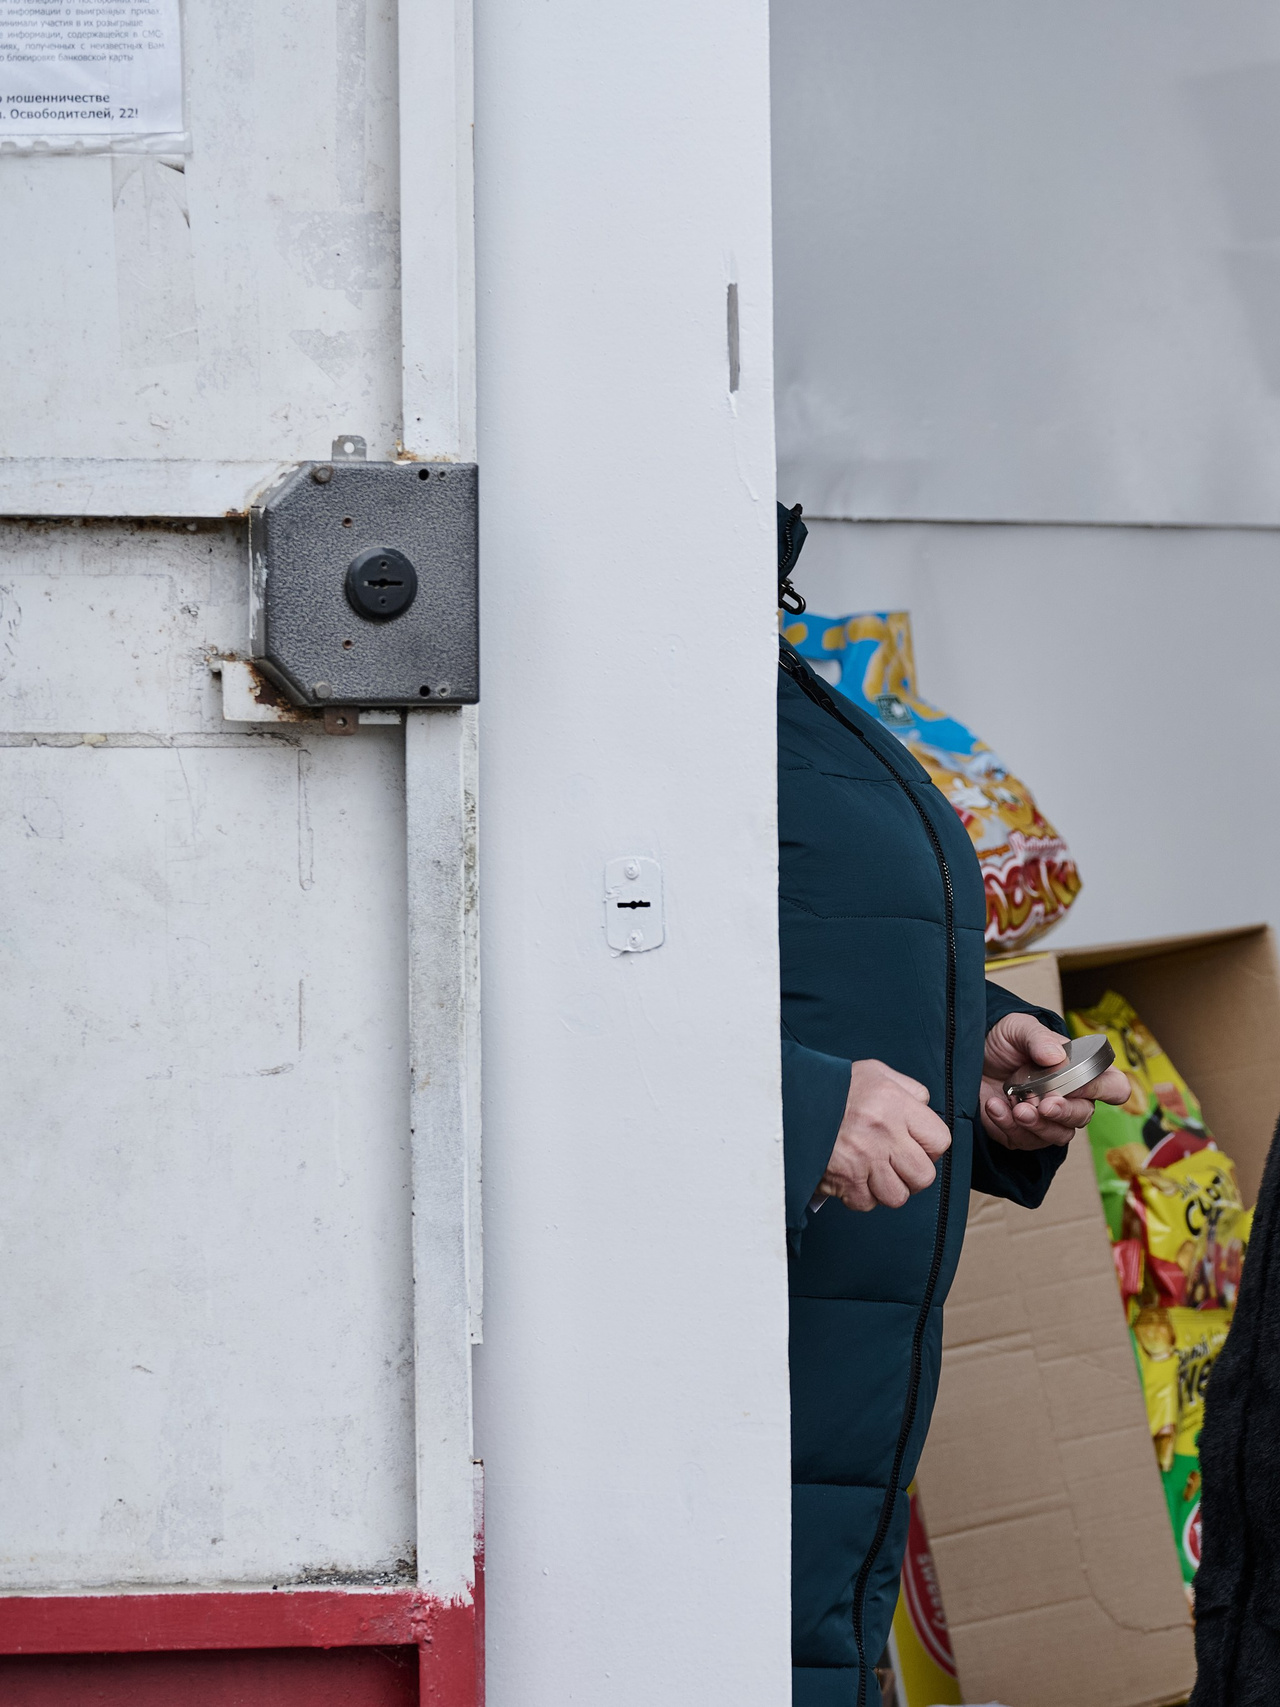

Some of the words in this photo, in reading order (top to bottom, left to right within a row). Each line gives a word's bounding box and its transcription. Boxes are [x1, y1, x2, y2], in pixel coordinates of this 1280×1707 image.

[7, 8, 61, 17] информации
[41, 20, 73, 28] участия
[96, 20, 144, 28] розыгрыше
[7, 31, 64, 40] информации,
[67, 30, 129, 39] содержащейся
[26, 43, 76, 51] полученных
[148, 42, 165, 50] Вам
[7, 53, 56, 63] блокировке
[58, 53, 107, 61] банковской
[109, 54, 134, 63] карты
[6, 94, 110, 103] мошенничестве
[10, 107, 115, 120] Освободителей,
[119, 108, 139, 118] 22!
